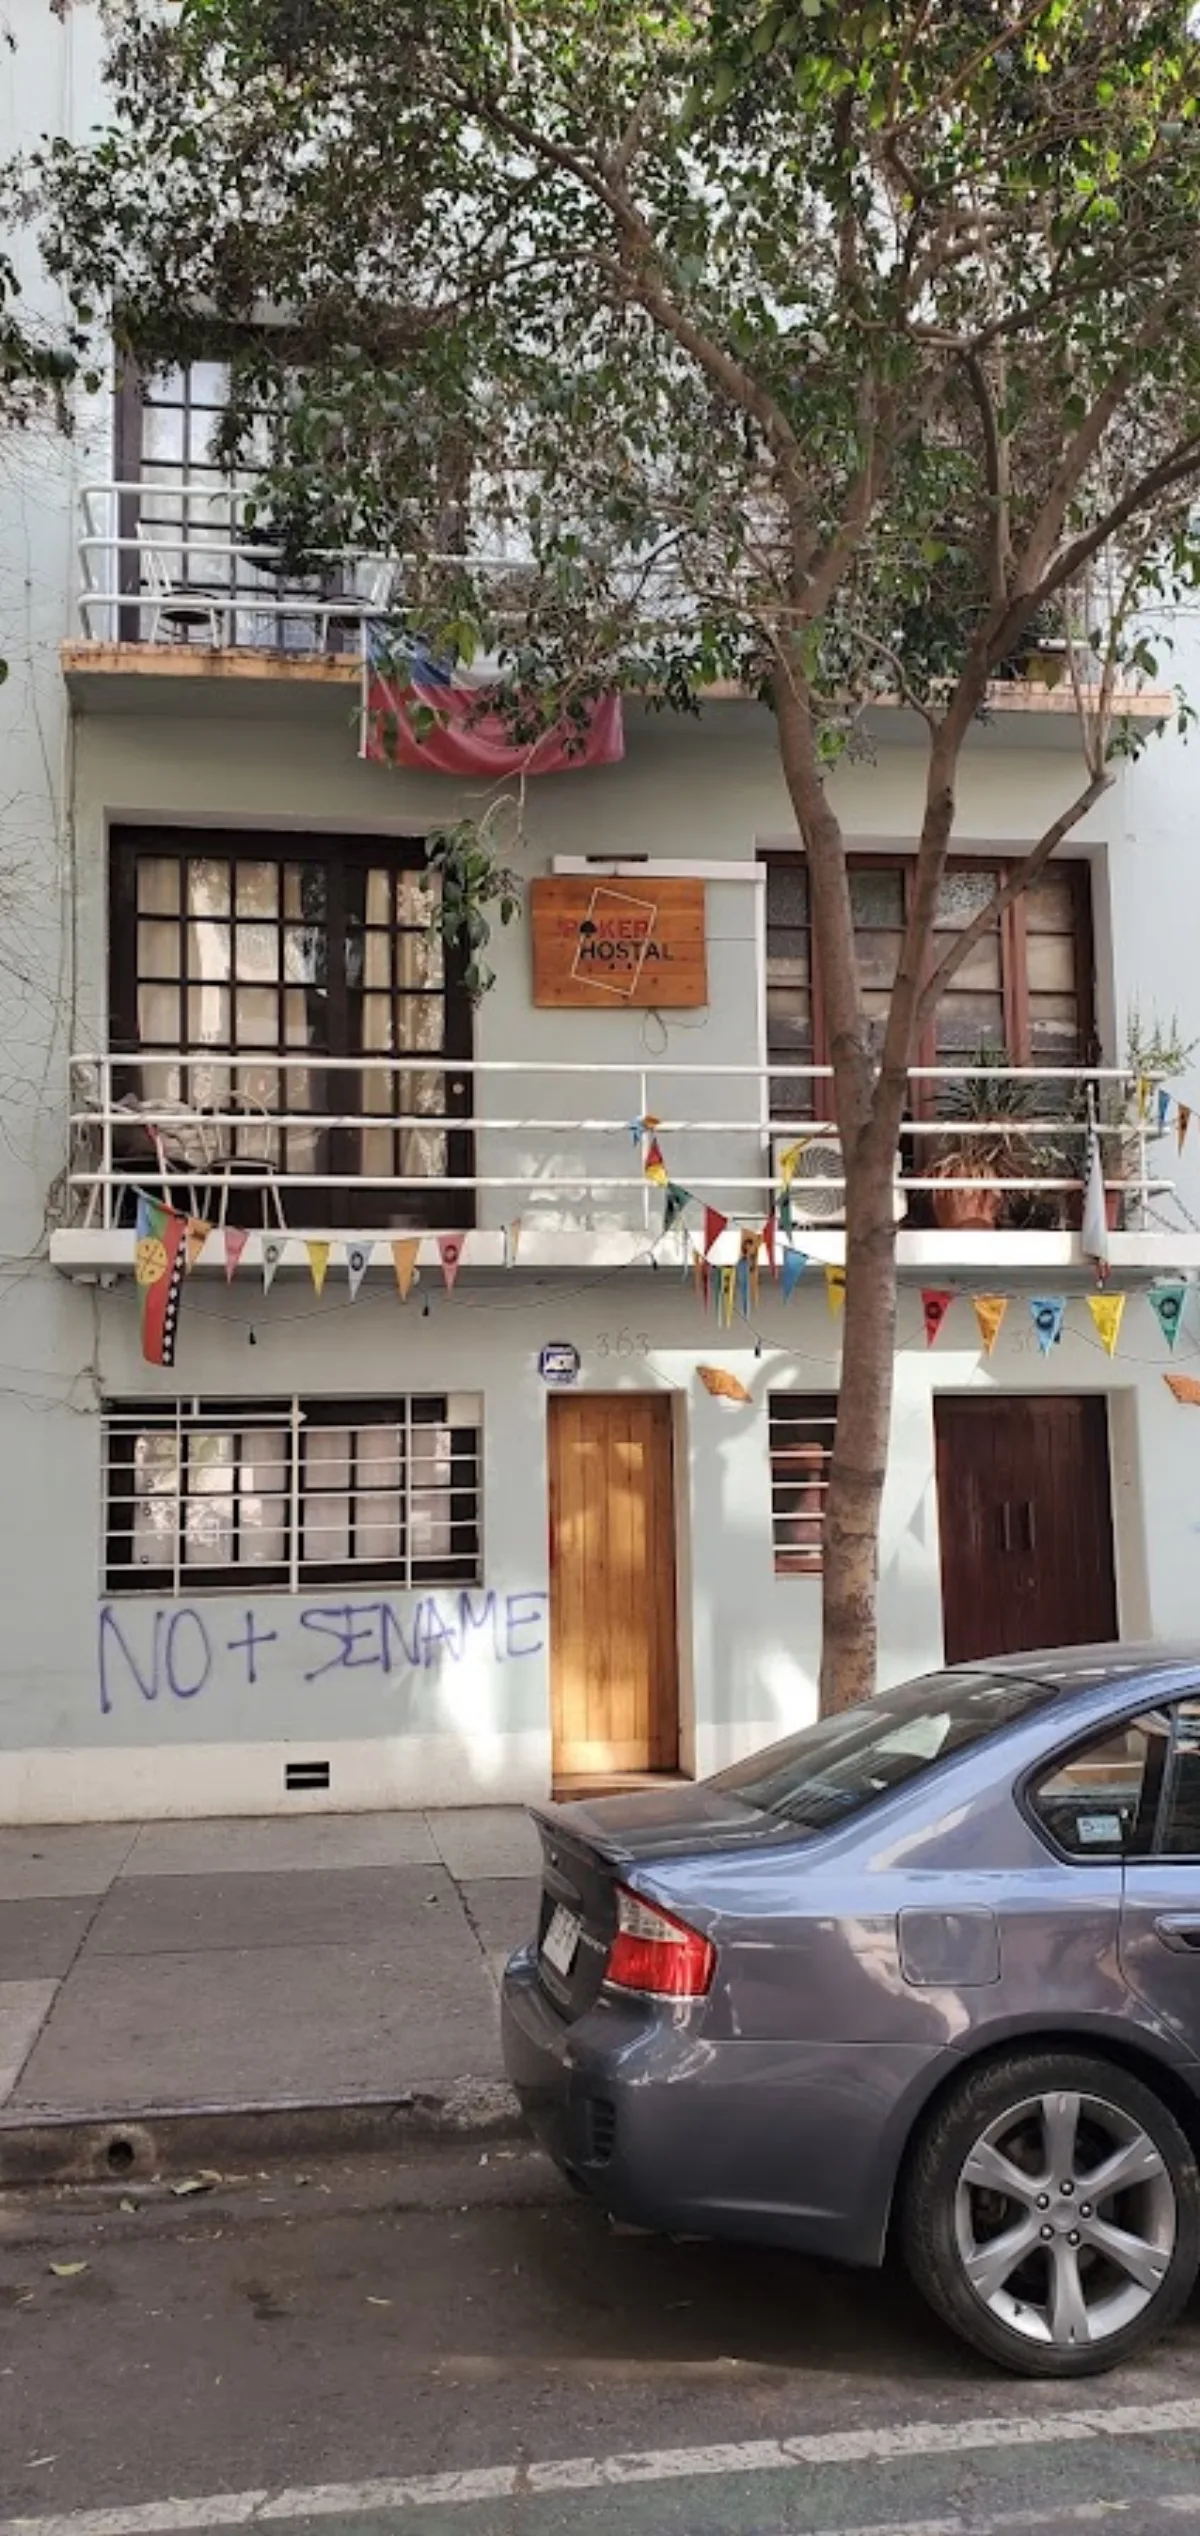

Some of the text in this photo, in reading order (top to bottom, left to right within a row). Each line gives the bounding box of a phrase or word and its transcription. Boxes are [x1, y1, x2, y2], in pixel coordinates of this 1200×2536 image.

[579, 940, 674, 961] HOSTAL
[596, 1325, 651, 1359] 363
[99, 1591, 548, 1714] NO + SENAME
